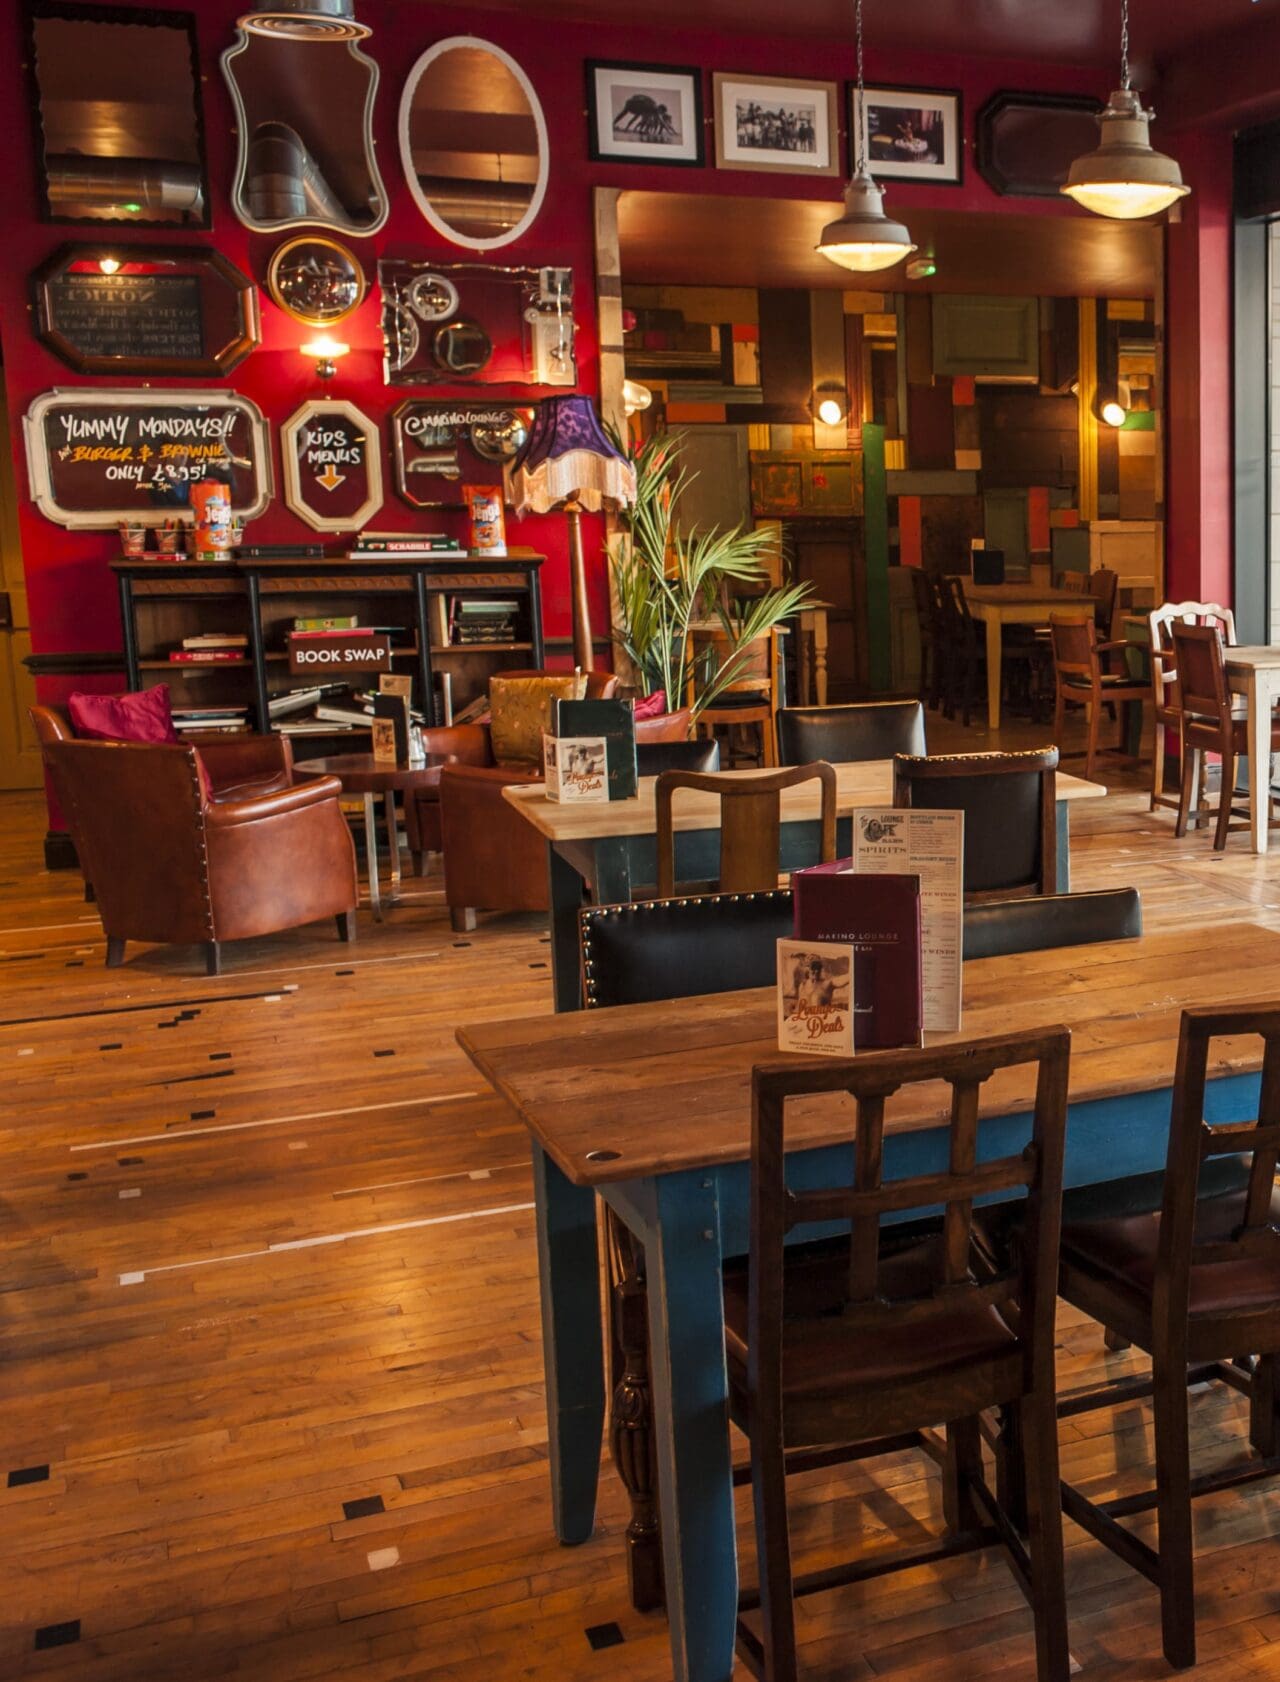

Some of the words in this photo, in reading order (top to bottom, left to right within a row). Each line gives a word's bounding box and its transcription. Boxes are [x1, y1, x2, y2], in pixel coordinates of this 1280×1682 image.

[60, 414, 129, 445] YUMMY
[70, 446, 134, 463] BURGER
[308, 447, 360, 463] MENUS
[106, 465, 144, 481] ONLY
[296, 649, 341, 663] BOOK
[344, 648, 385, 661] SWAP
[859, 846, 907, 854] SPIRITS
[806, 1015, 844, 1039] Deals
